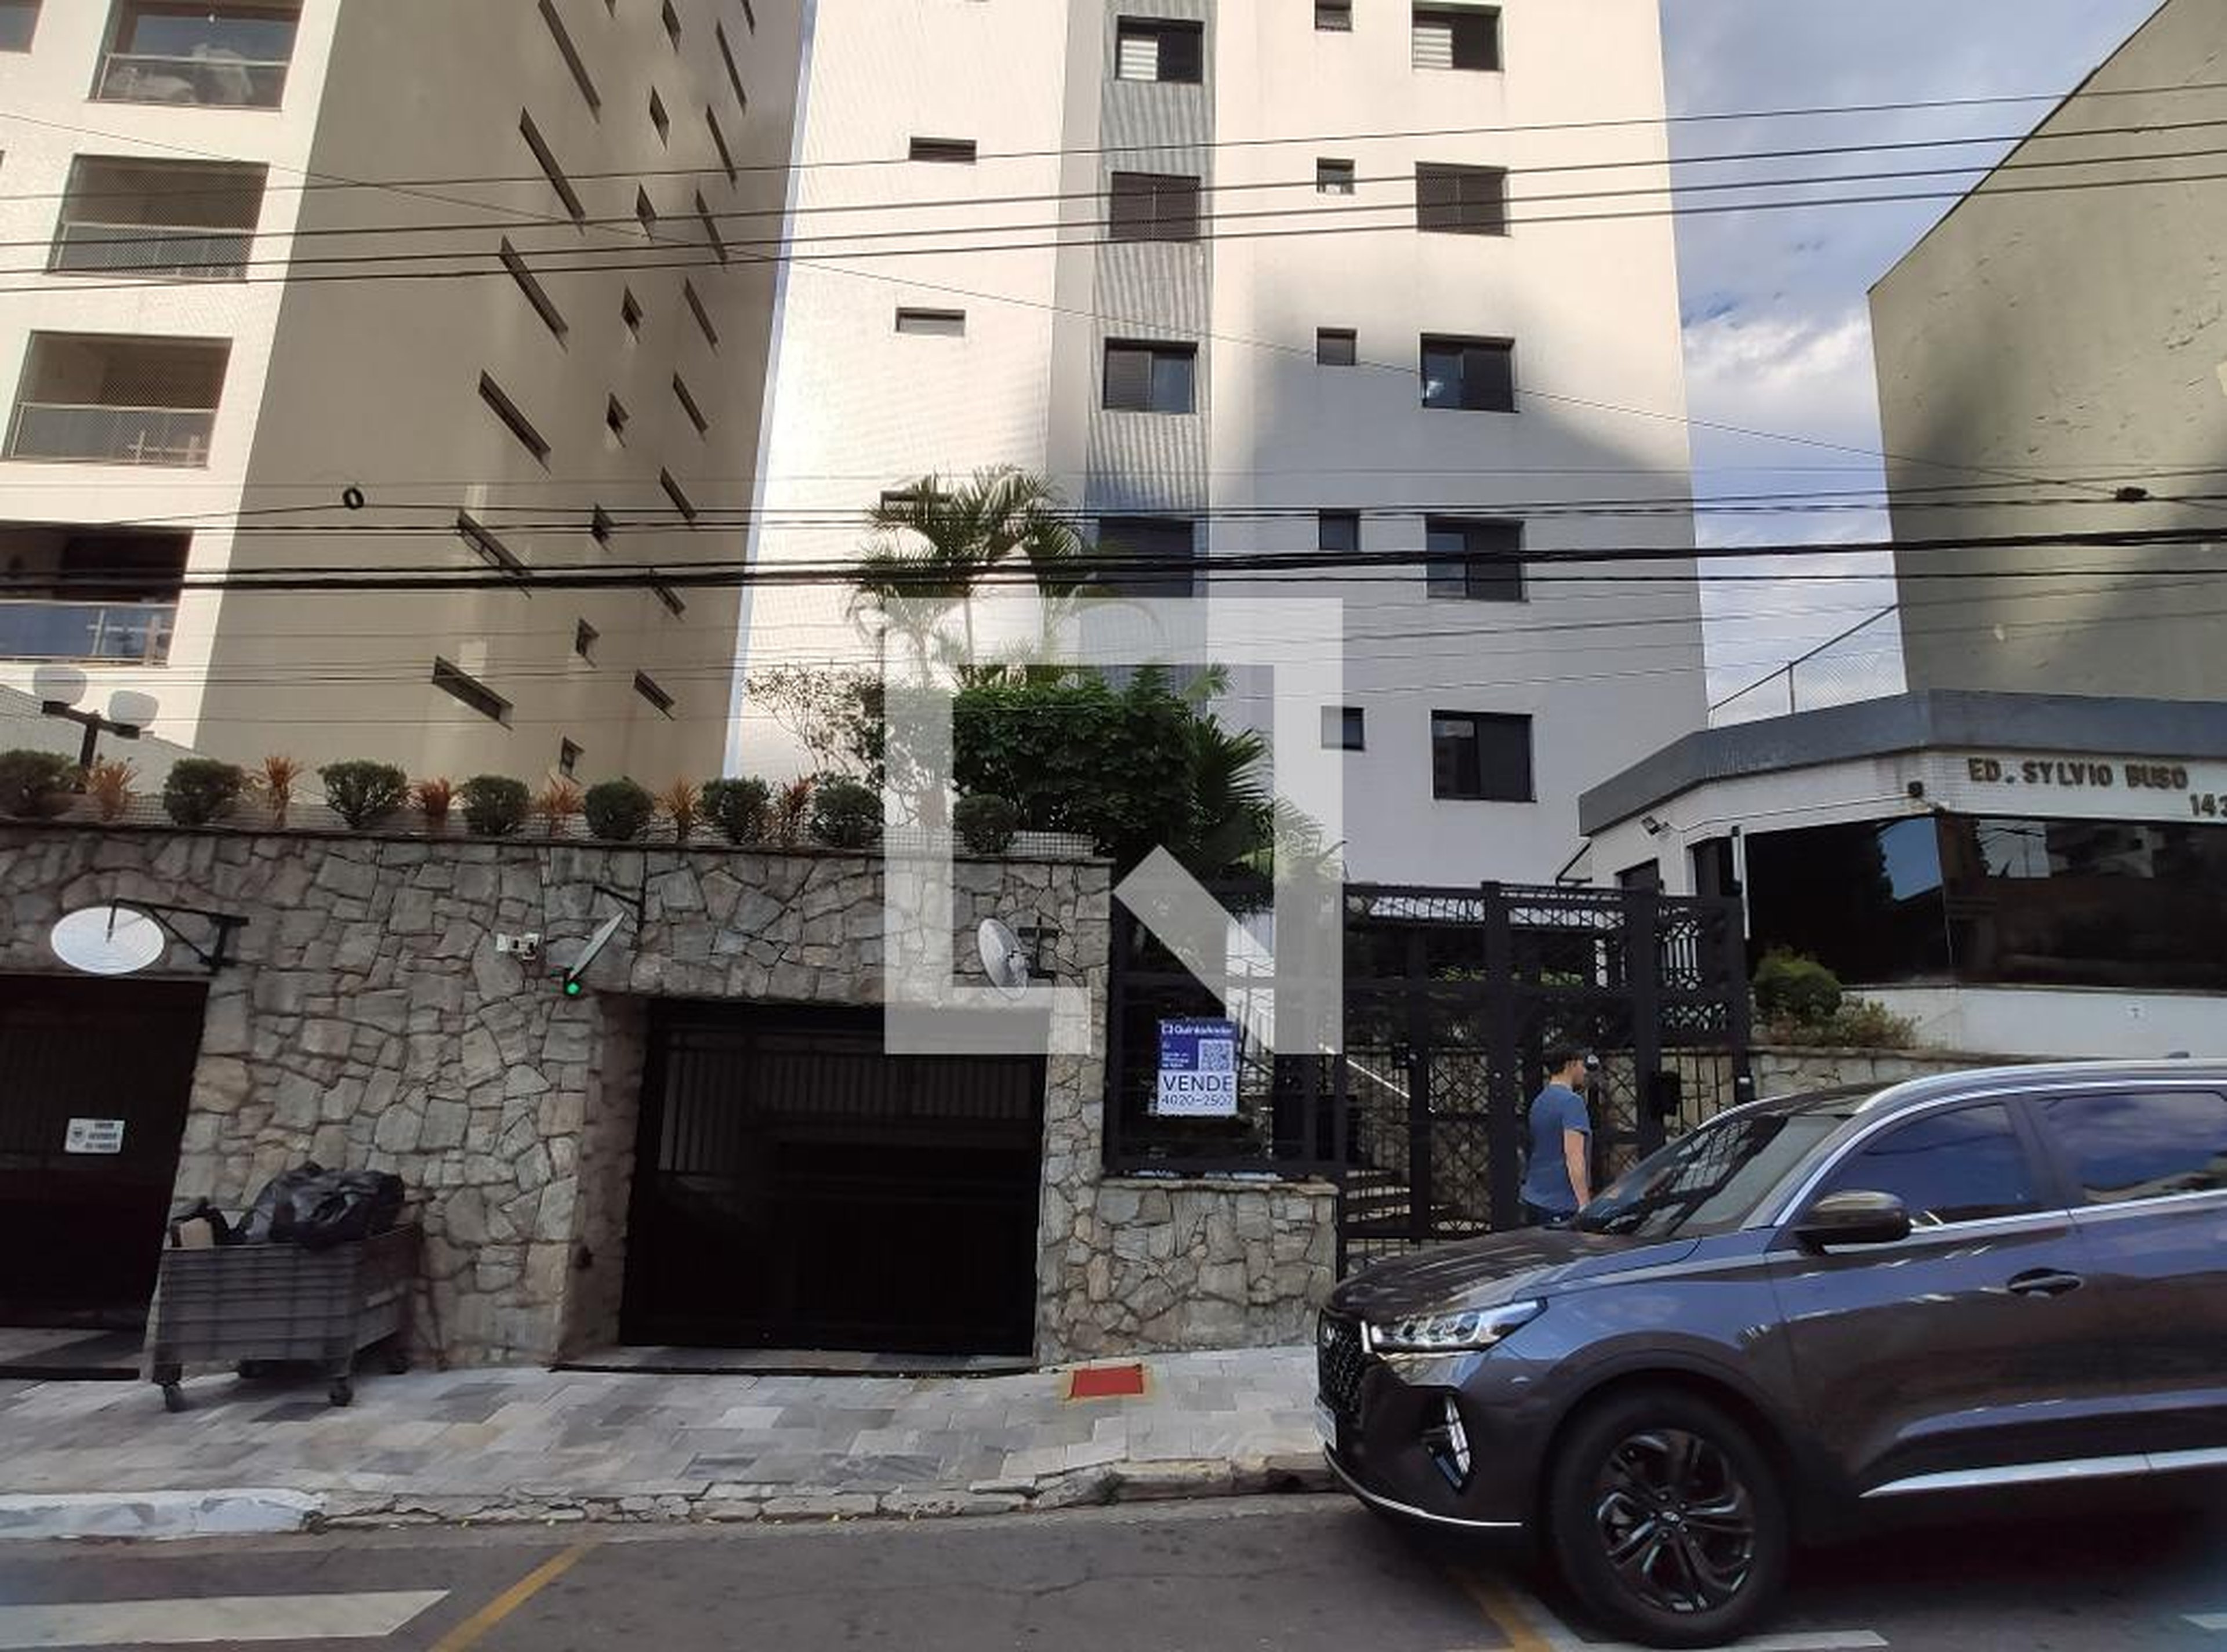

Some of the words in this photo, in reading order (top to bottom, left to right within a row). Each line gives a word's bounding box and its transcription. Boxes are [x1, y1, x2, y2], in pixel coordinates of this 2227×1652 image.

[1968, 758, 2015, 783] ED.
[2022, 760, 2113, 786] SYLVIO
[1163, 1075, 1232, 1091] VENDE
